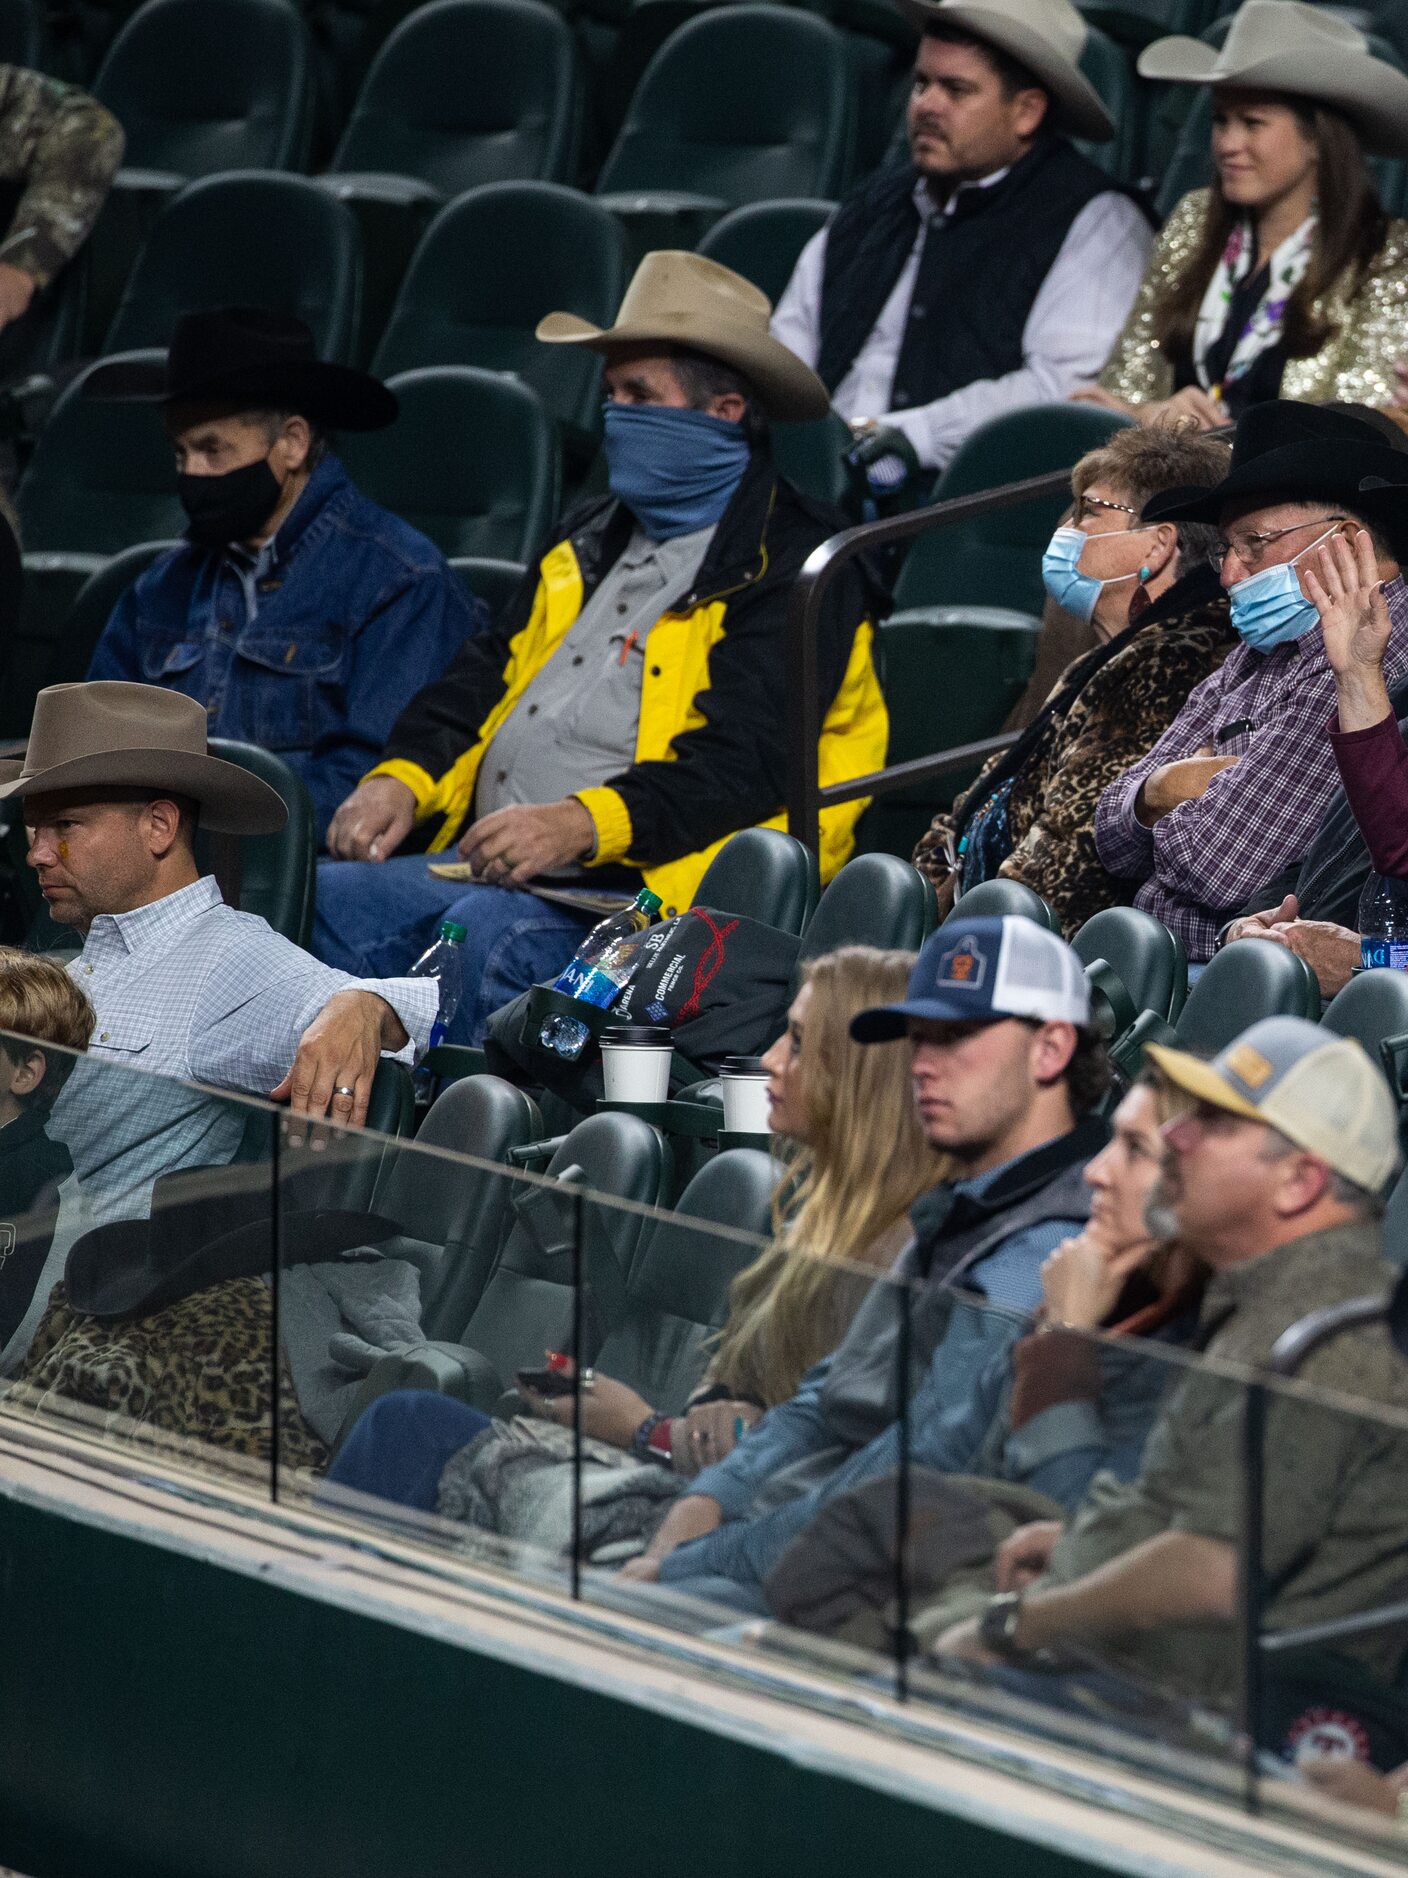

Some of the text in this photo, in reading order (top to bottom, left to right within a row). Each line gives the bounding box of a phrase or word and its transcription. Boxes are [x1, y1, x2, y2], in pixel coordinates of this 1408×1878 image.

[646, 933, 665, 950] SB
[655, 953, 687, 1001] COMMERCIAL
[619, 984, 636, 1010] ARENA
